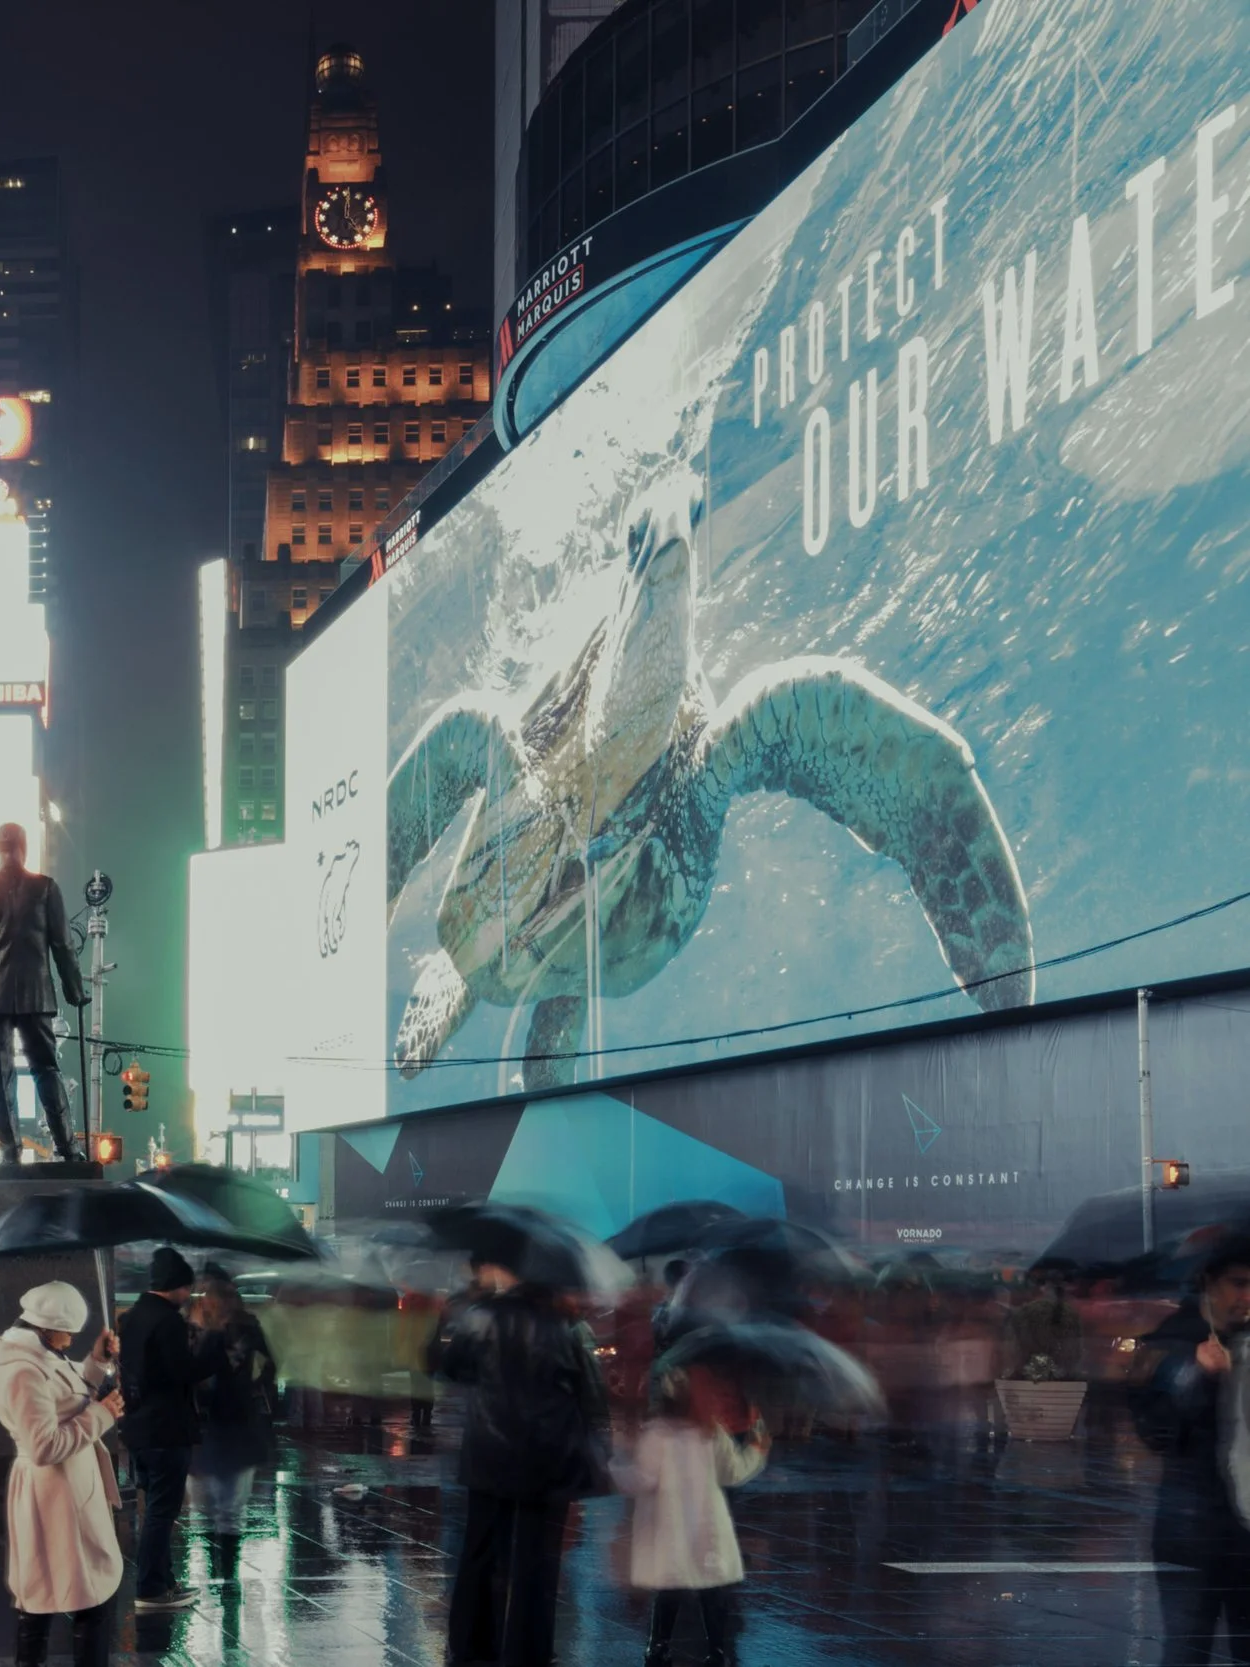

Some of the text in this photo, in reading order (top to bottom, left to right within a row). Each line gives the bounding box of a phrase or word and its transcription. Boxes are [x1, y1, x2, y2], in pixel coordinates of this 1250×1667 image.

[517, 236, 593, 317] MARRIOTT
[517, 271, 581, 341] MARQUIS
[753, 195, 948, 428] PROTECT
[803, 335, 929, 557] OUR
[385, 509, 421, 553] MARRIOTT
[385, 531, 417, 569] MARQUIS
[312, 769, 358, 824] NRDC
[384, 1200, 407, 1208] CHANGE
[418, 1198, 449, 1207] CONSTANT
[834, 1171, 1019, 1191] CHANGE IS CONSTANT
[896, 1228, 943, 1239] VORNADO
